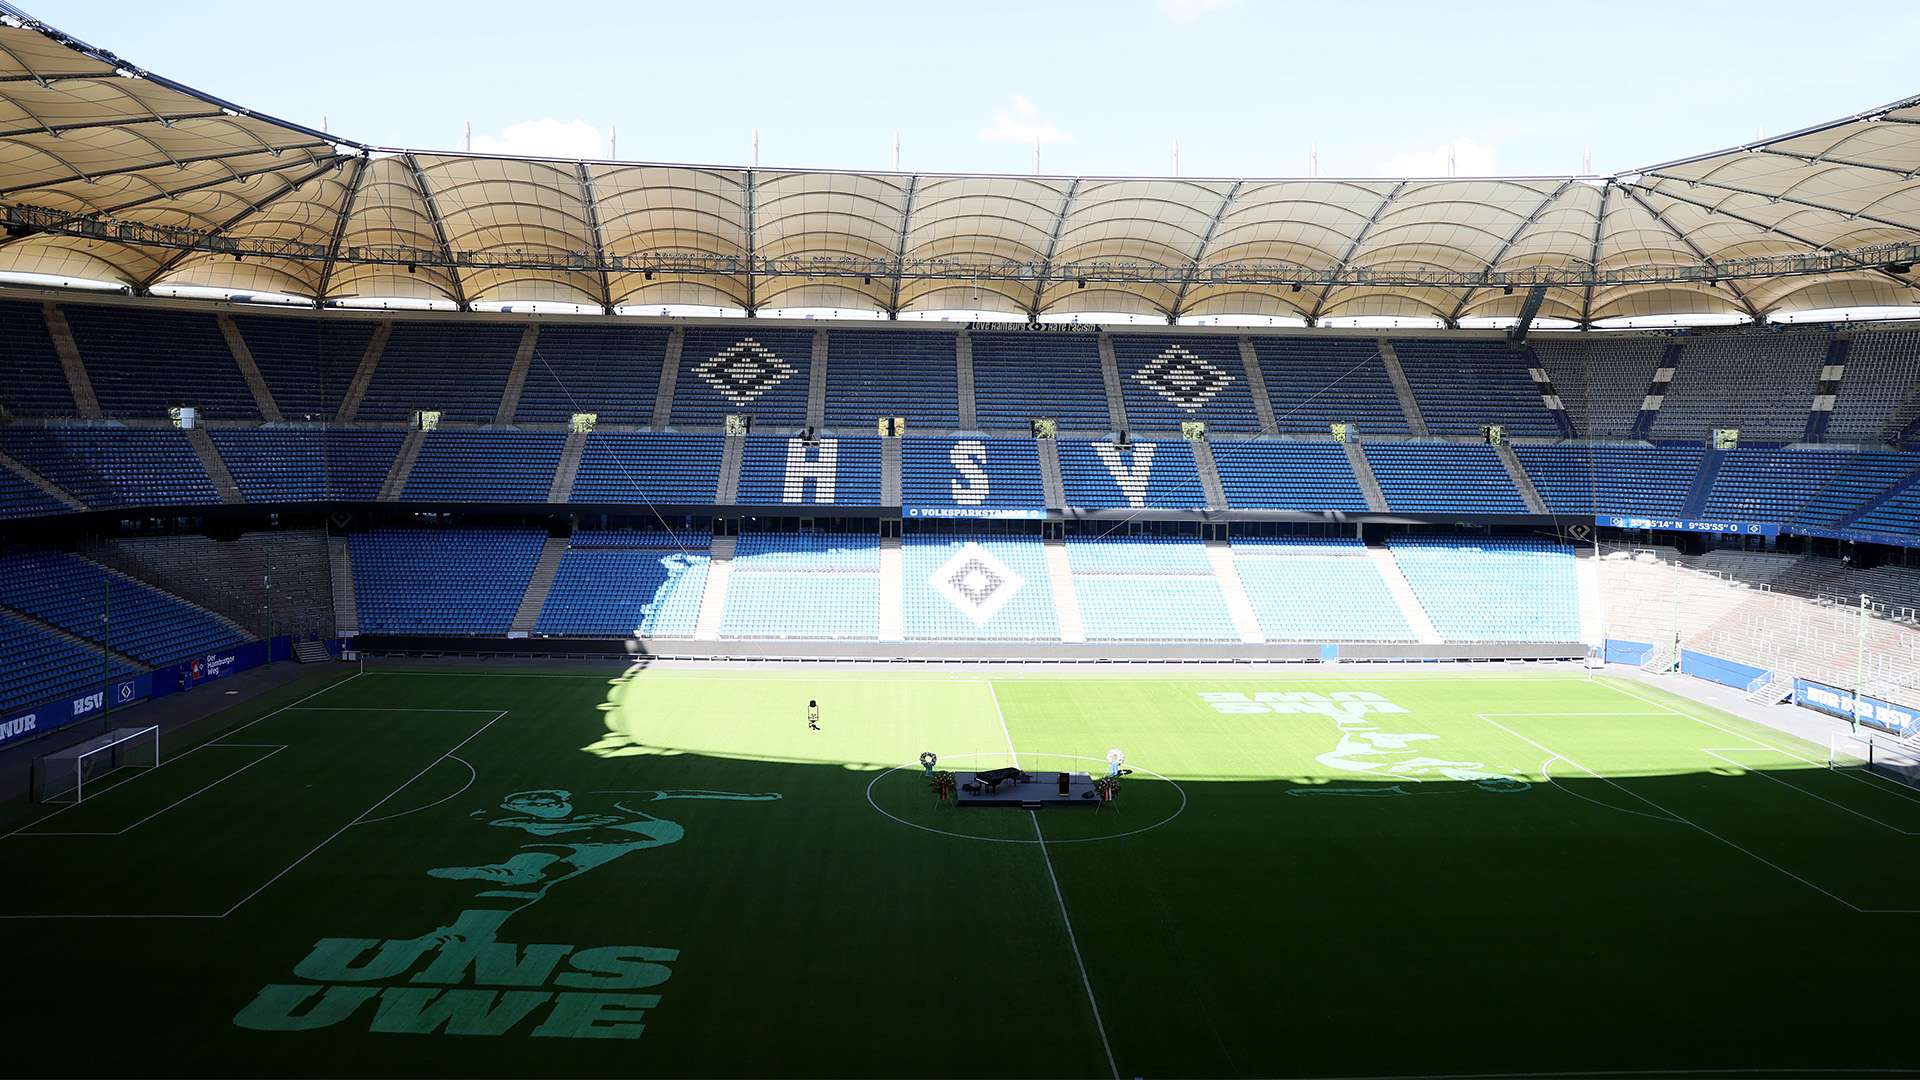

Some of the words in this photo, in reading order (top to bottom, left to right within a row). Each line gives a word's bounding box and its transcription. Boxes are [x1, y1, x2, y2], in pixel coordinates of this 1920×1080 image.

[73, 691, 104, 716] HSV
[290, 937, 681, 991] UNS
[231, 984, 664, 1040] UWE
